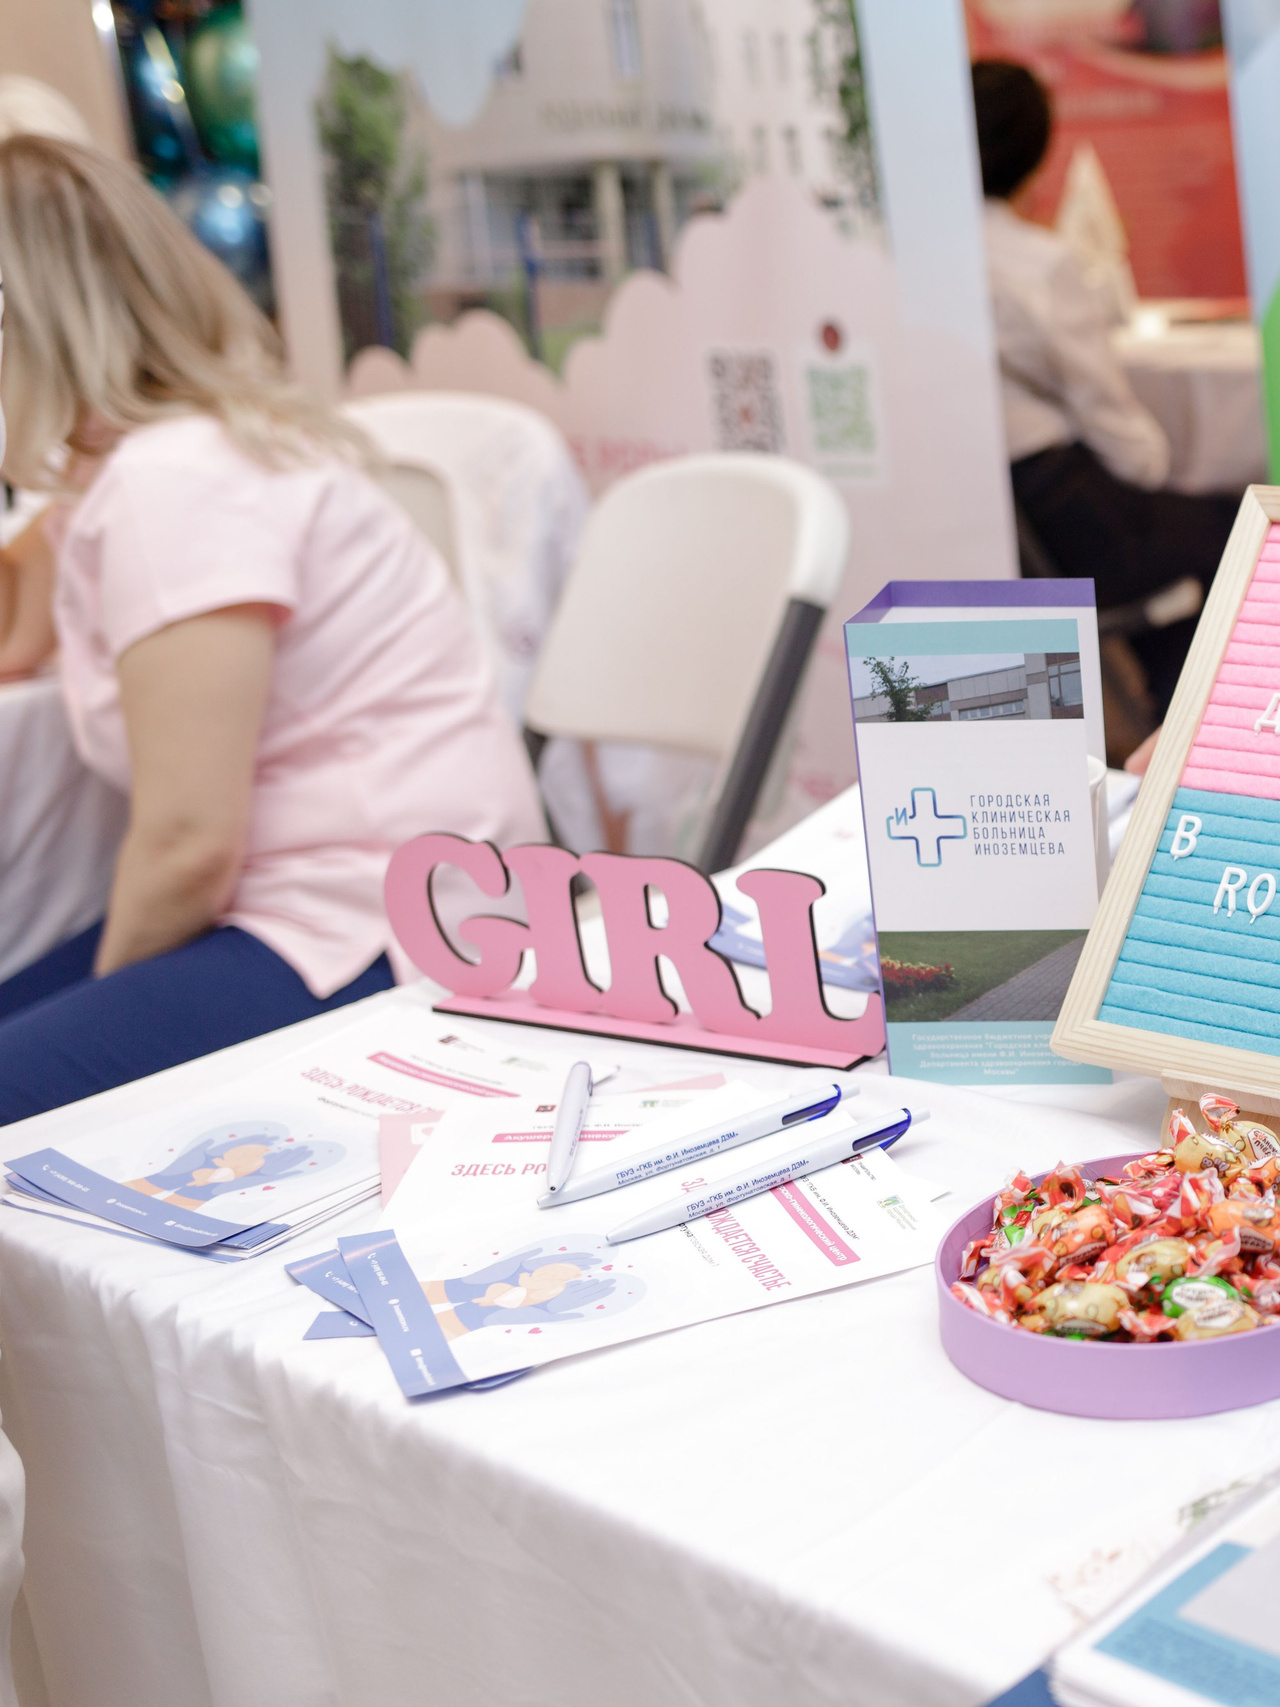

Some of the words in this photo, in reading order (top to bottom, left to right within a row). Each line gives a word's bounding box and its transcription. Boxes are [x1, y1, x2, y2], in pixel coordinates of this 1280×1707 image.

[970, 793, 1050, 808] ГОРОДСКАЯ
[971, 809, 1071, 824] КЛИНИЧЕСКАЯ
[973, 826, 1046, 840] БОЛЬНИЦА
[1169, 815, 1203, 861] В
[974, 842, 1065, 856] ИНОЗЕМЦЕВА
[384, 831, 887, 1058] GIRL
[451, 1163, 516, 1177] ЗДЕСЬ
[615, 1168, 635, 1180] ГБУЗ
[665, 1152, 680, 1162] Ф.И.
[681, 1137, 720, 1157] Иноземцева
[686, 1199, 706, 1212] ГБУЗ
[736, 1182, 751, 1193] Ф.И.
[751, 1167, 791, 1186] Иноземцева
[705, 1208, 762, 1258] ОЖДАЕТСЯ
[740, 1253, 792, 1292] СЧАСТЬЕ
